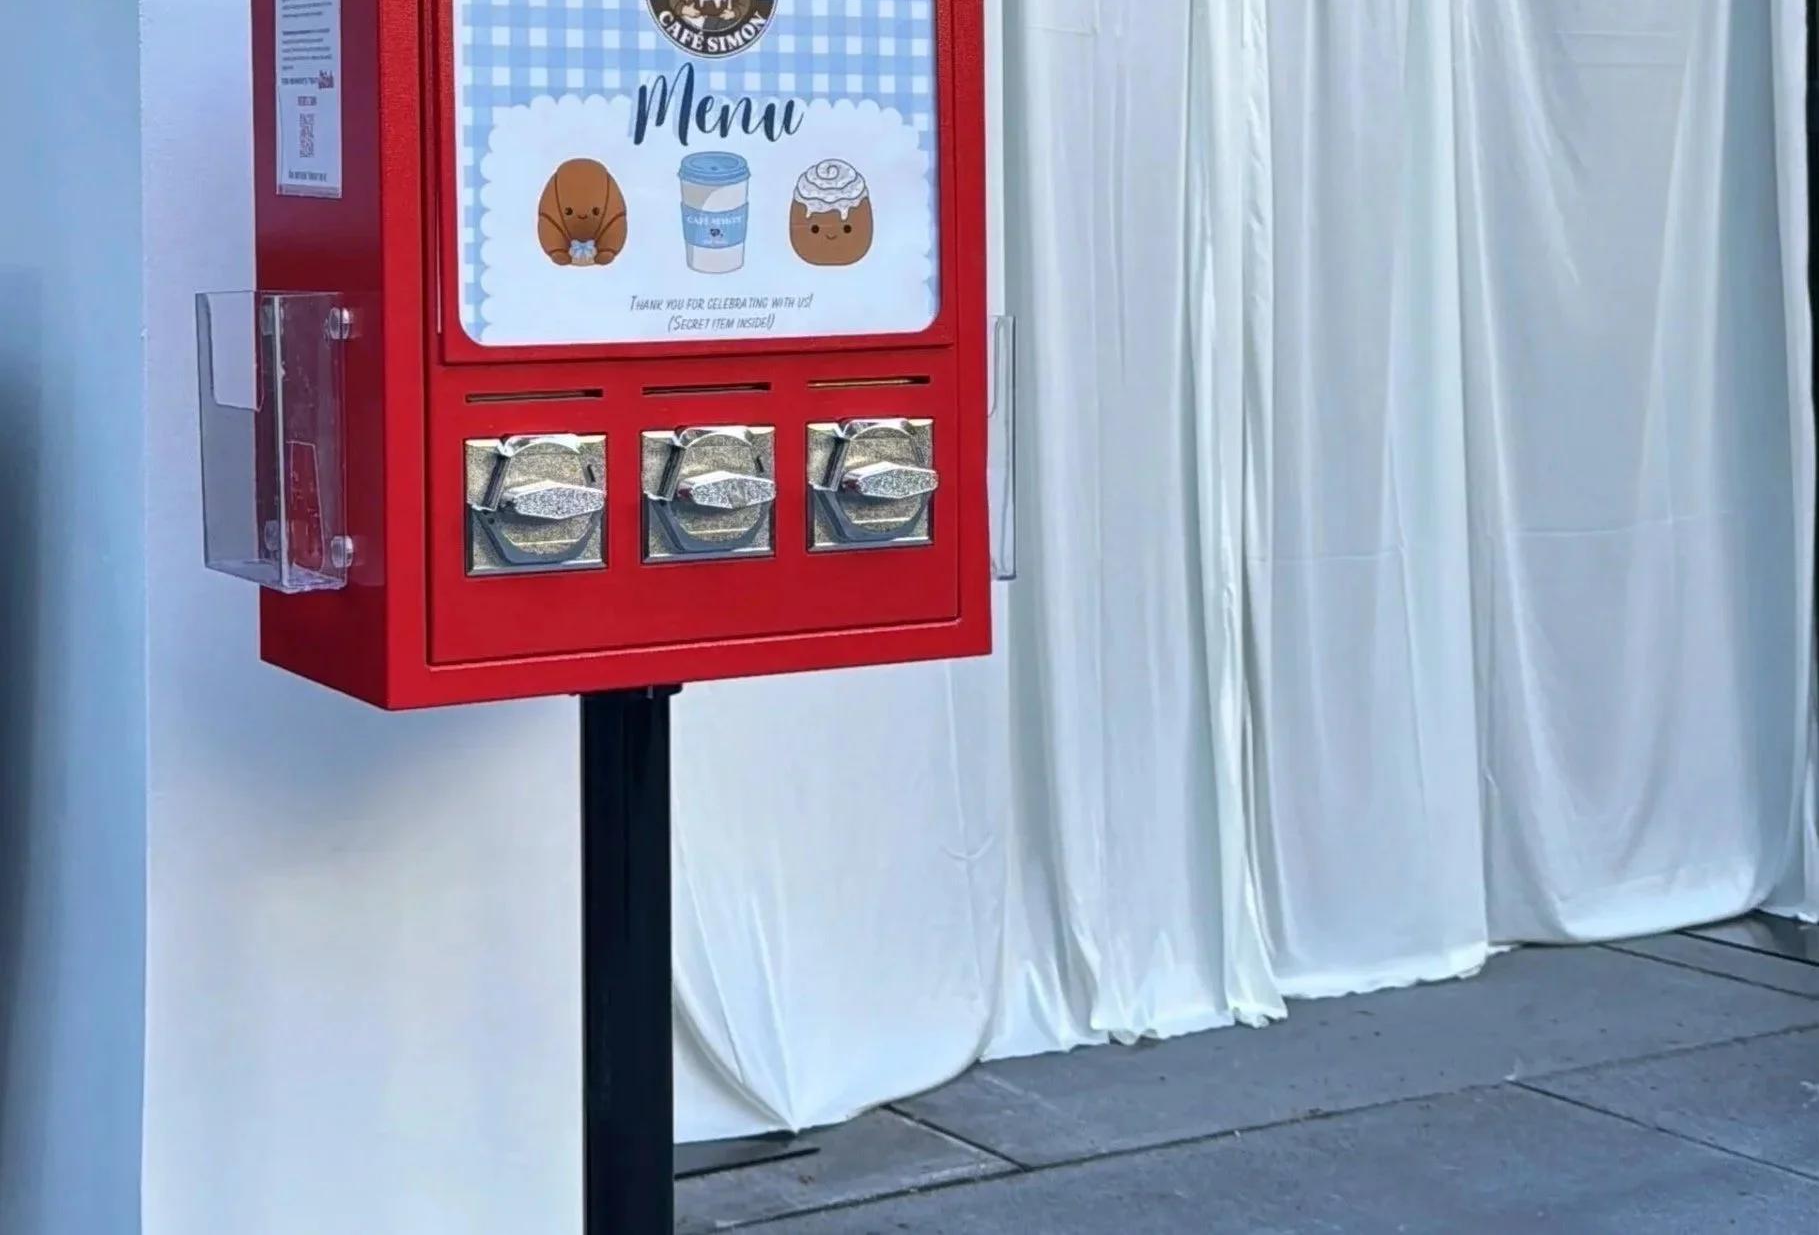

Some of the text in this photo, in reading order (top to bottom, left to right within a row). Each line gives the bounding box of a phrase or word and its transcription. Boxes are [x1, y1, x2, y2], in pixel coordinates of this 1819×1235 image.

[659, 11, 767, 52] CAFÉ SIMON
[634, 62, 804, 146] Menu
